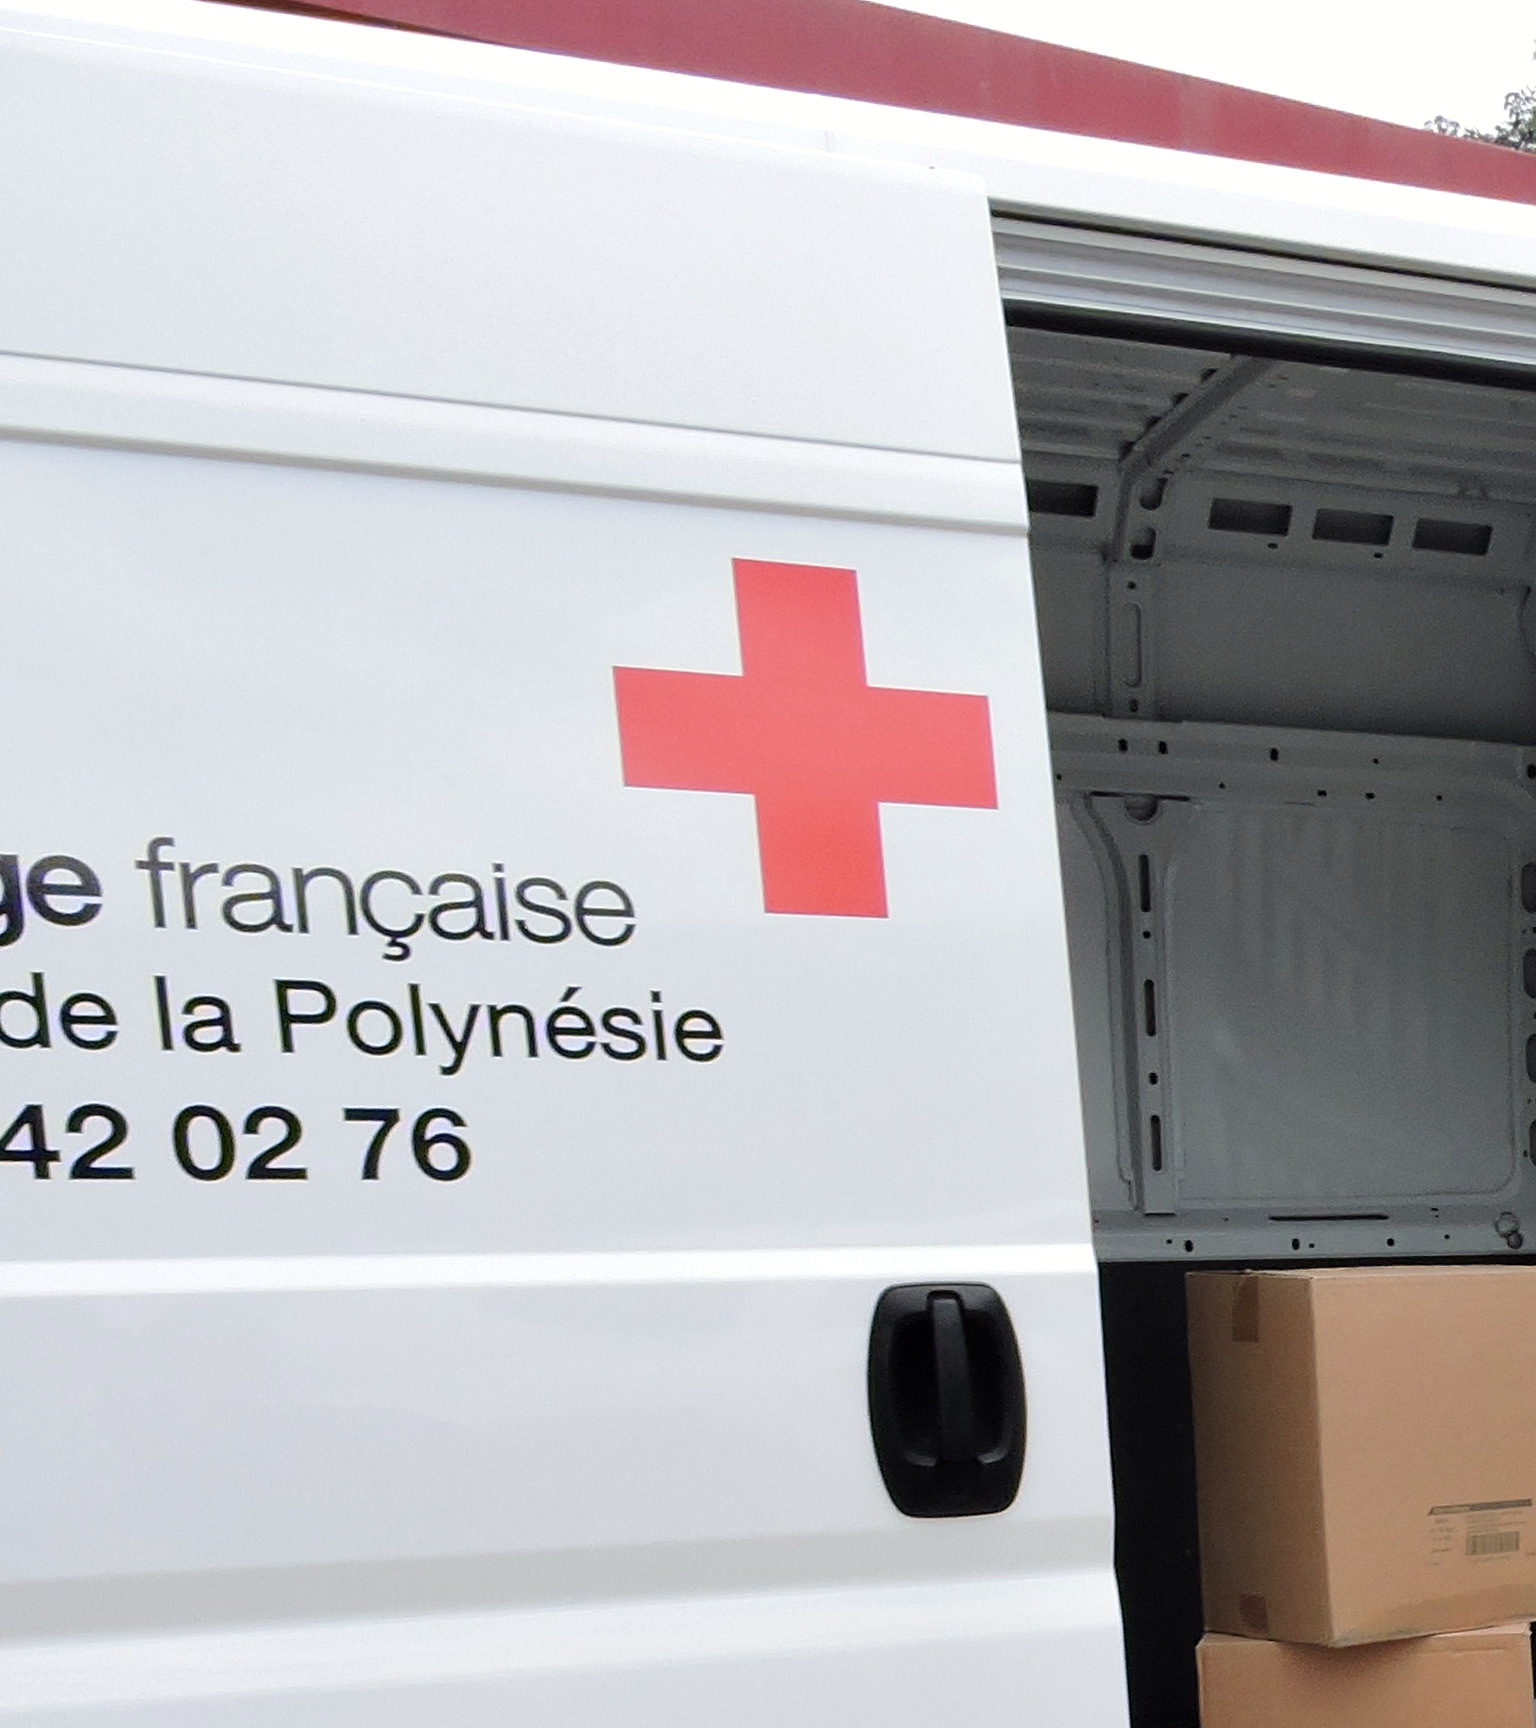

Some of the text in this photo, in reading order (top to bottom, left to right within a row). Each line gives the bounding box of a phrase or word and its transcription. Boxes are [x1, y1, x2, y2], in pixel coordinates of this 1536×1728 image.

[134, 836, 637, 962] française
[0, 971, 724, 1076] de la Polynésie
[0, 1103, 473, 1182] 42 02 76
